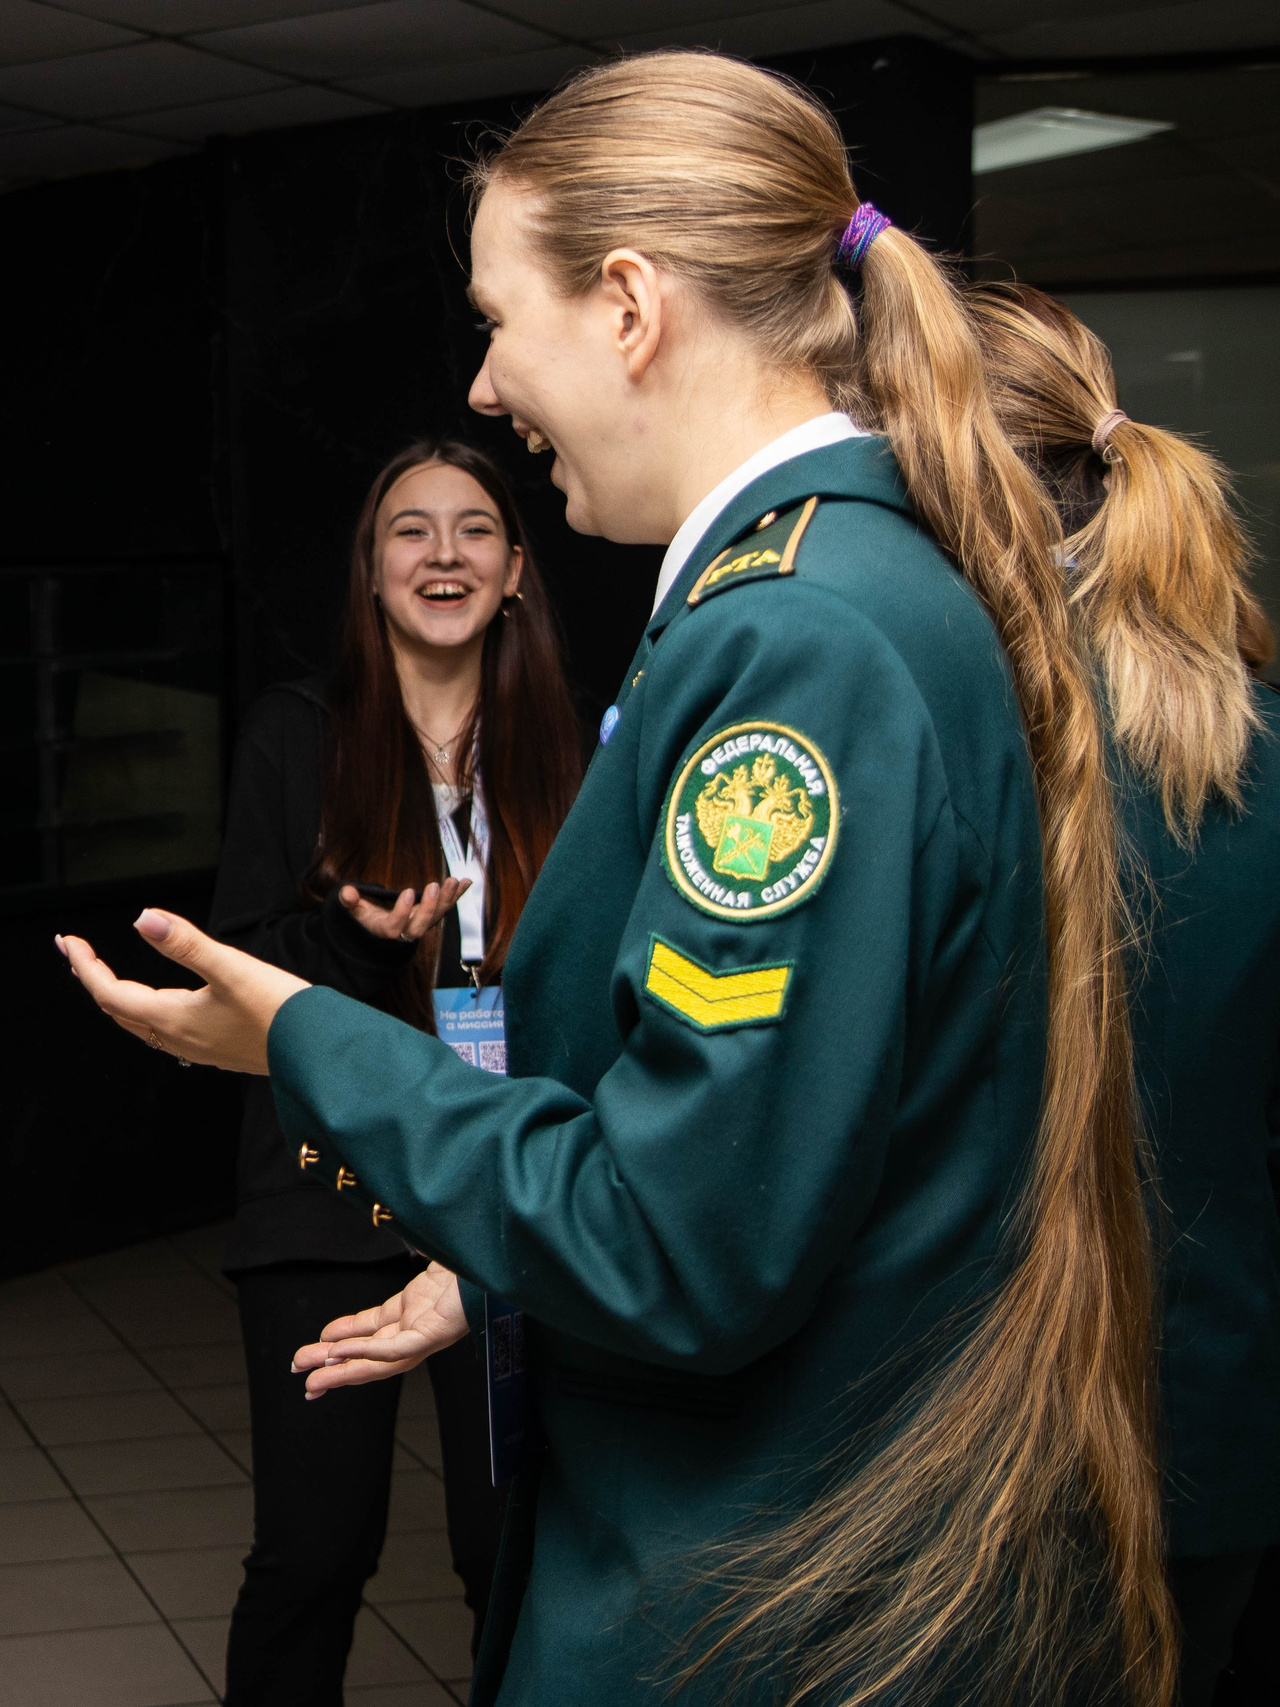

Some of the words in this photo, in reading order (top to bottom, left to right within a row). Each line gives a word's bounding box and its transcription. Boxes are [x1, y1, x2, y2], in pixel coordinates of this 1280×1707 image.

[701, 733, 826, 796] ФЕДЕРАЛЬНАЯ
[676, 812, 752, 908] ТАМОЖЕННАЯ
[761, 836, 826, 903] СЛУЖБА
